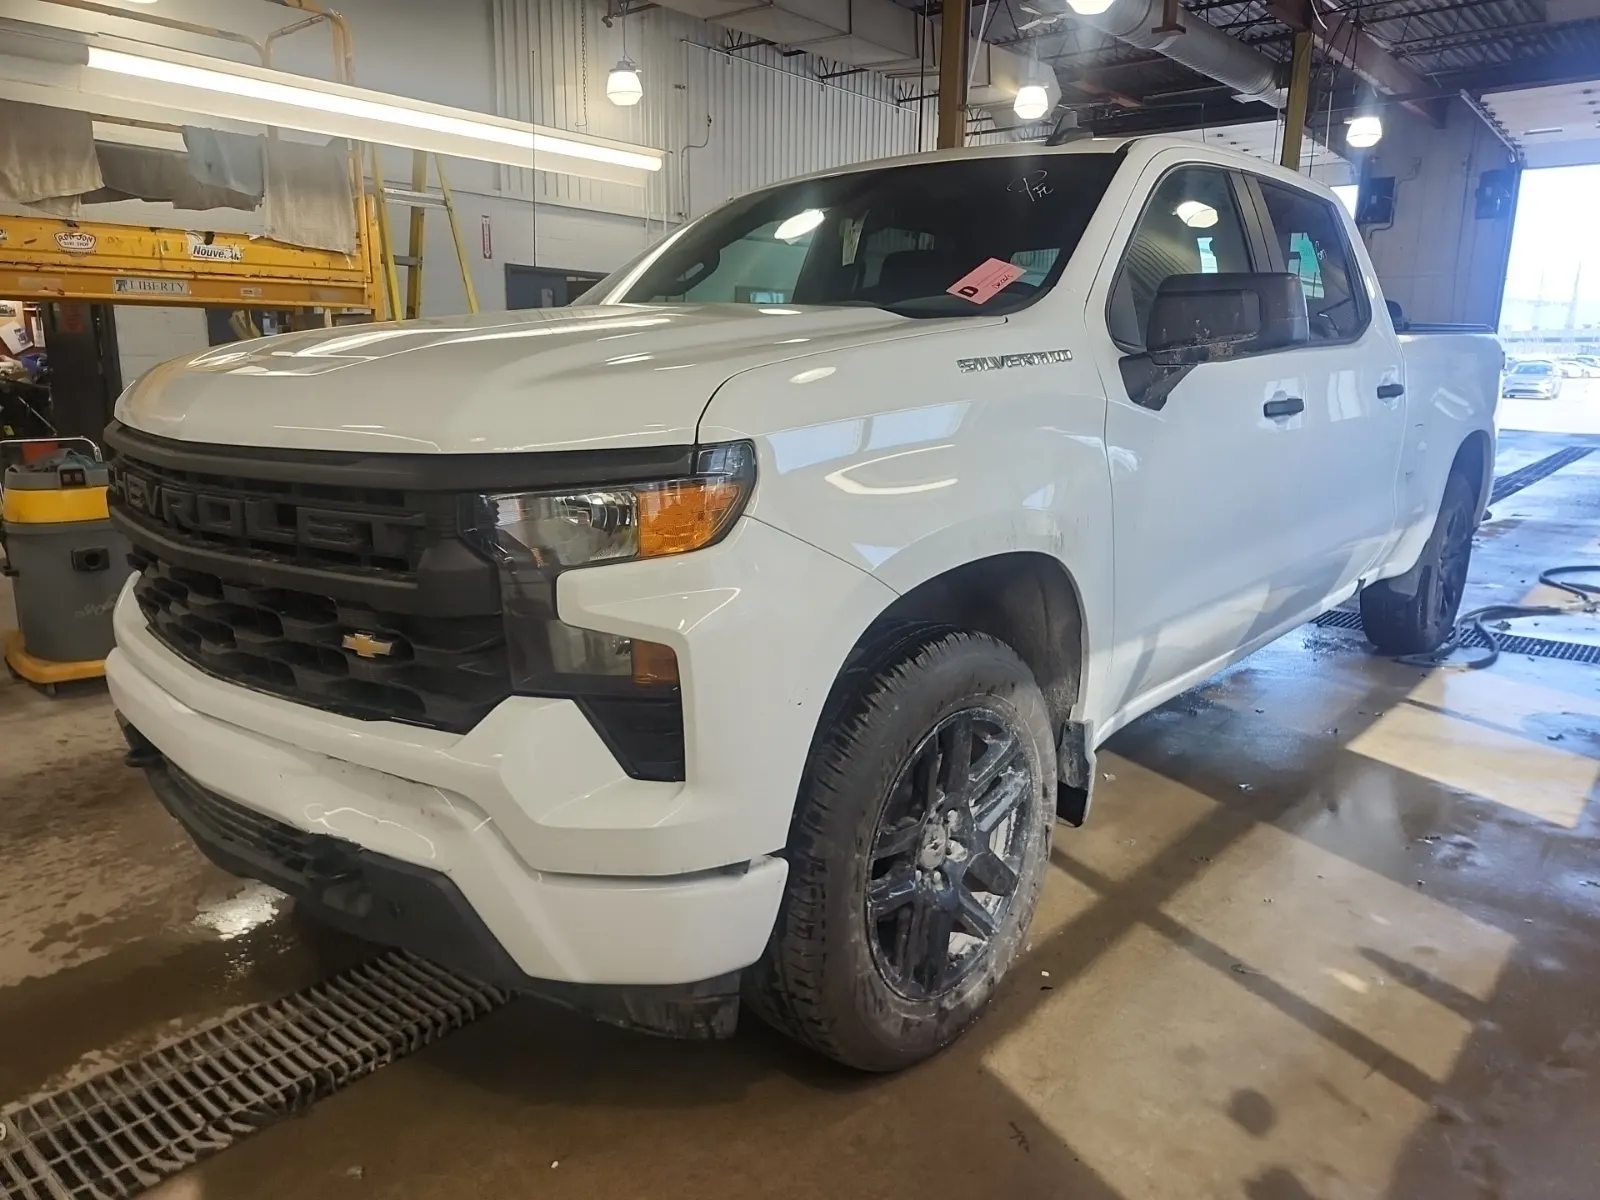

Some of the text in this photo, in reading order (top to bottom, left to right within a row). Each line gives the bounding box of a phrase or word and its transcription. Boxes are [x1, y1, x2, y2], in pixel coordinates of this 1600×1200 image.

[76, 234, 93, 243] JON
[129, 280, 185, 292] LIBERTY
[957, 285, 979, 298] D
[956, 349, 1073, 373] SILVERADO
